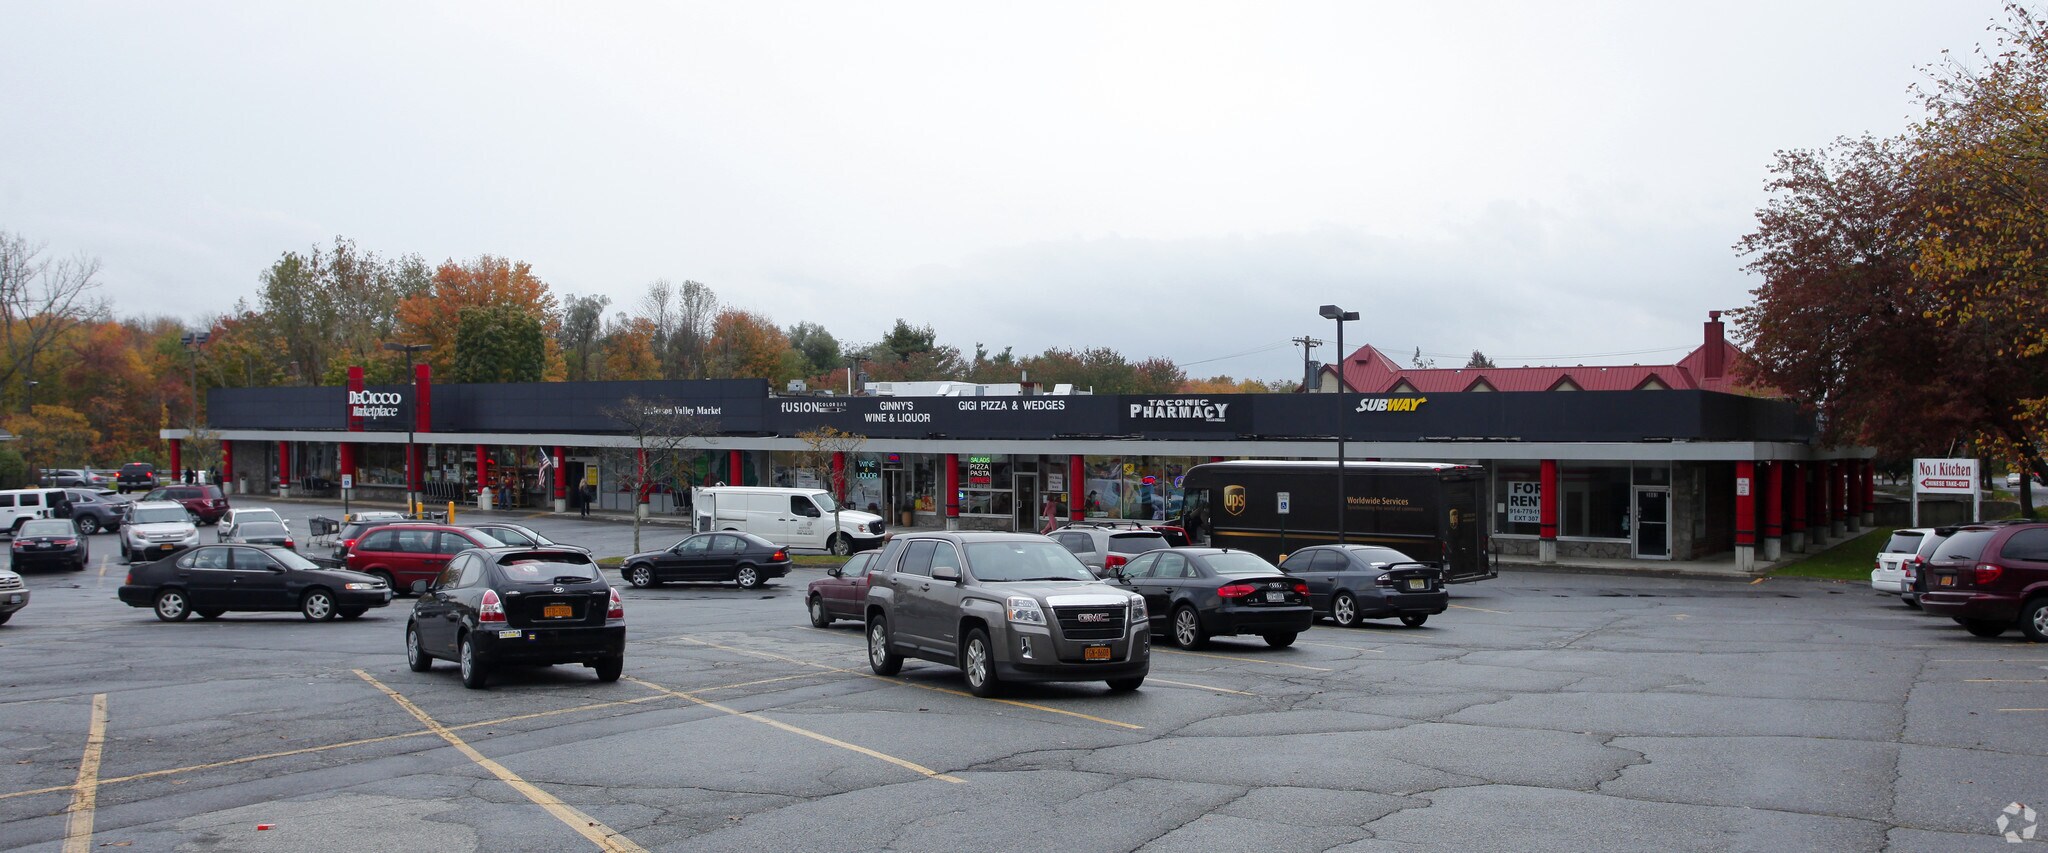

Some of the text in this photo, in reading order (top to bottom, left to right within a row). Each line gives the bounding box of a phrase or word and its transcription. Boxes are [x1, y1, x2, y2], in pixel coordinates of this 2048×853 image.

[880, 402, 913, 411] GINNY'S
[958, 400, 1066, 410] GIGI PIZZA & WEDGES
[1355, 397, 1427, 412] SUBWAY
[353, 405, 398, 420] Marketplace
[675, 406, 694, 416] Valley
[697, 406, 721, 415] Market
[1130, 404, 1229, 418] PHARMACY
[864, 413, 931, 422] WINE & LIQUOR
[858, 460, 875, 468] WINE
[1939, 462, 1971, 476] Kitchen
[1514, 483, 1541, 494] FOR
[1347, 496, 1409, 506] Worldwide Services
[1510, 496, 1541, 506] REN
[1078, 613, 1109, 622] GMC
